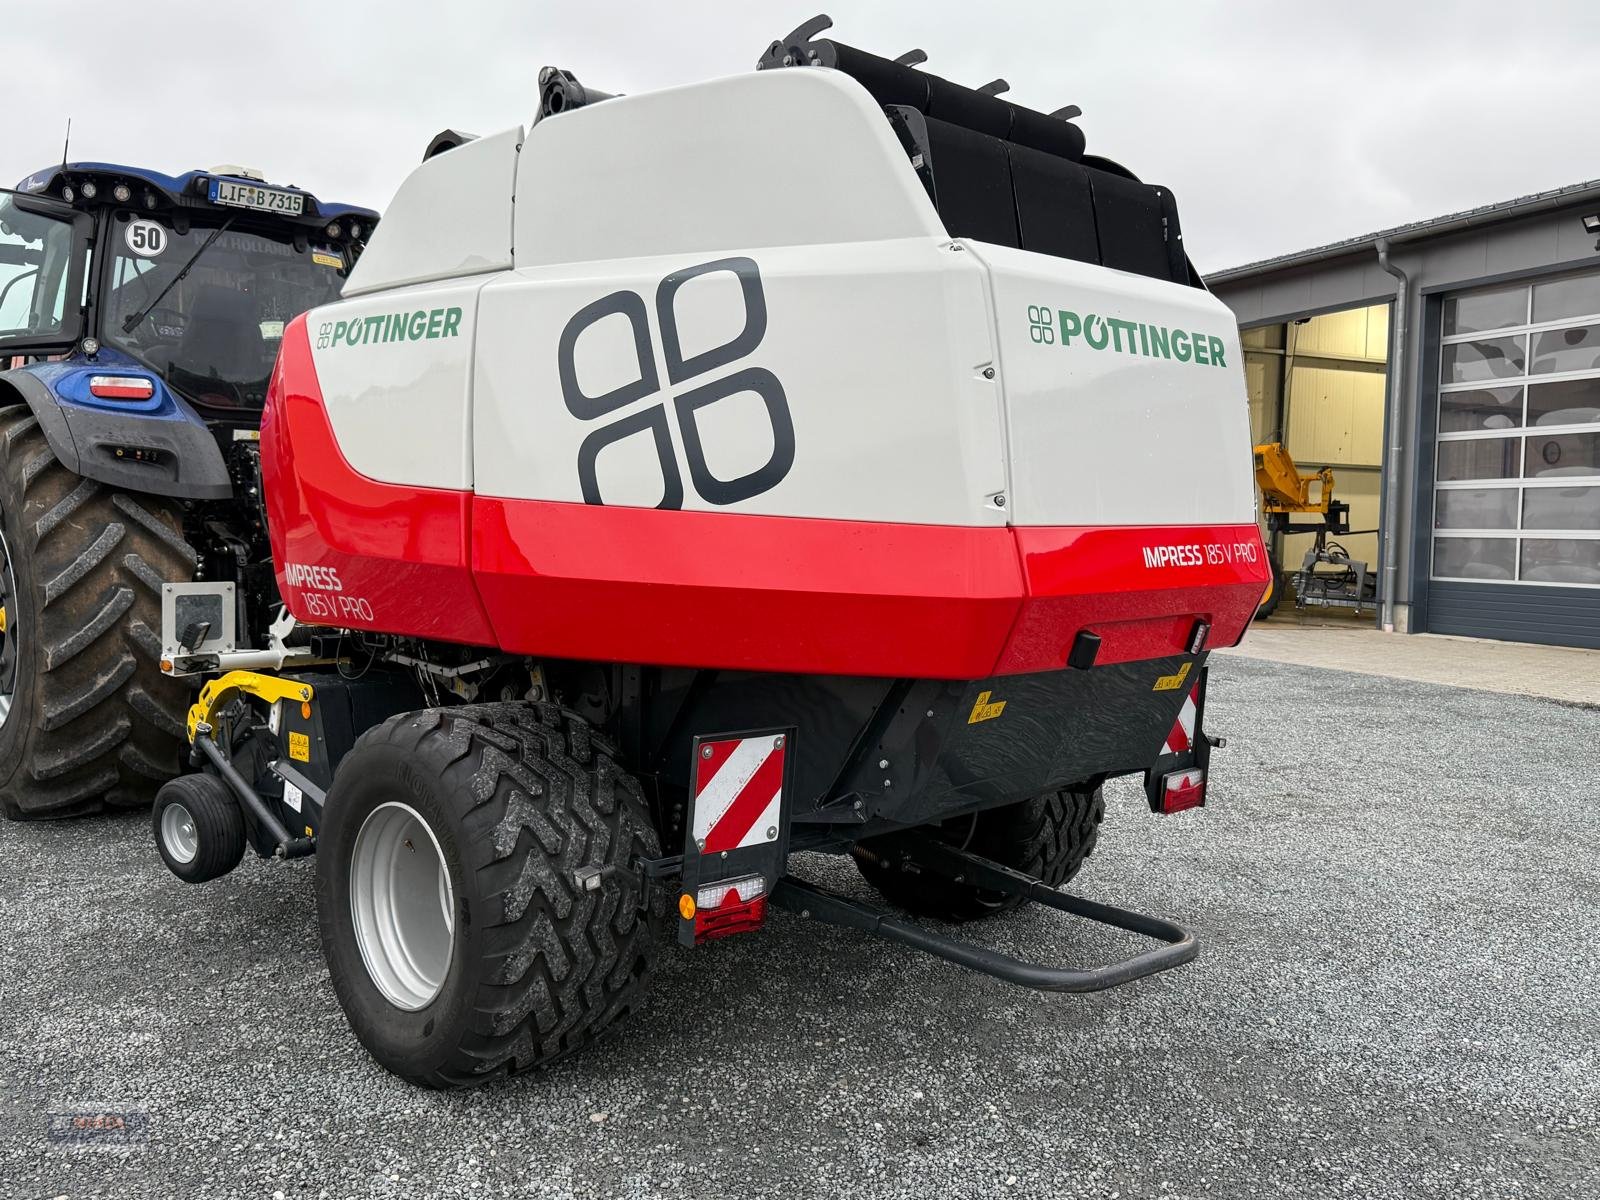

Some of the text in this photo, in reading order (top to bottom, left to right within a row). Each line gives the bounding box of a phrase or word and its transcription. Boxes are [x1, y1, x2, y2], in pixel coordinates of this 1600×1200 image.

[219, 183, 301, 212] LIF B 7315
[133, 225, 161, 250] 50
[331, 307, 462, 347] PÖTTINGER
[1058, 310, 1228, 368] PÖTTINGER
[1142, 545, 1204, 569] IMPRESS
[1233, 543, 1257, 563] PRO
[285, 562, 343, 591] IMPRESS
[339, 596, 374, 622] PRO
